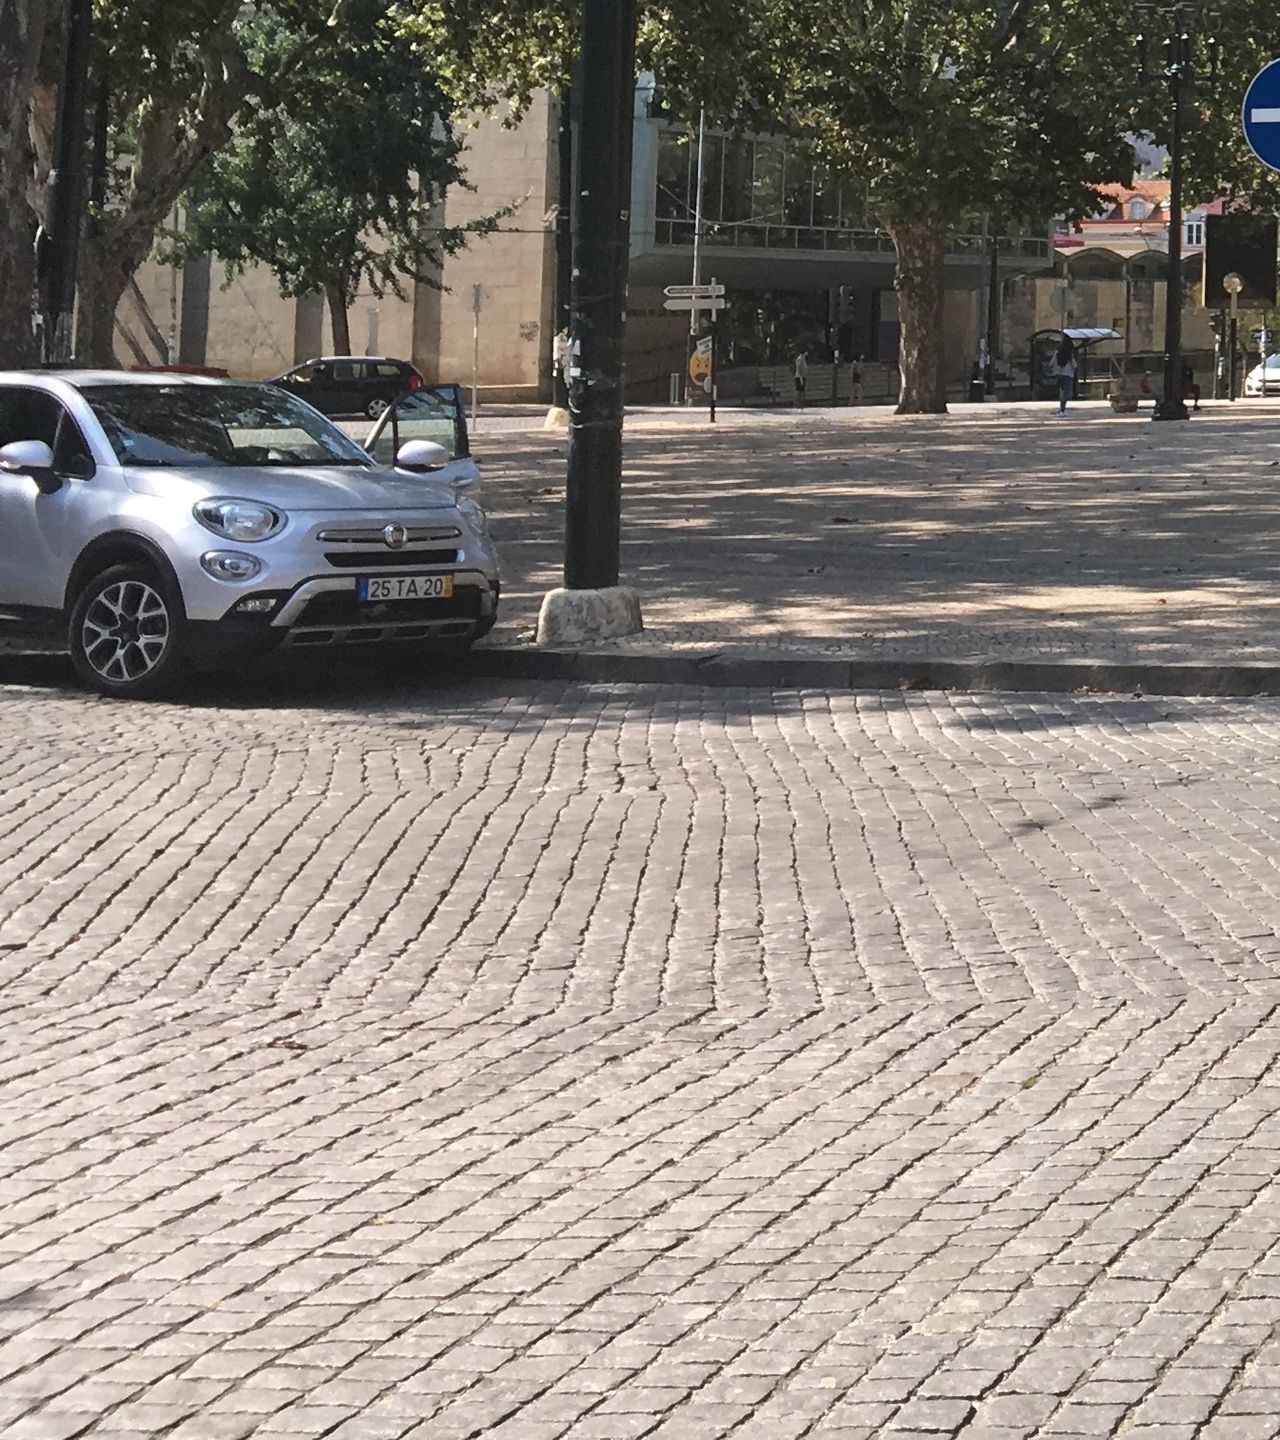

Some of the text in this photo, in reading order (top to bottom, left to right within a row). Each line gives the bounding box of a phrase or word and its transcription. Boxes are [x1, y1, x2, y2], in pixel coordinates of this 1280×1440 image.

[370, 577, 443, 598] 25 TA 20
